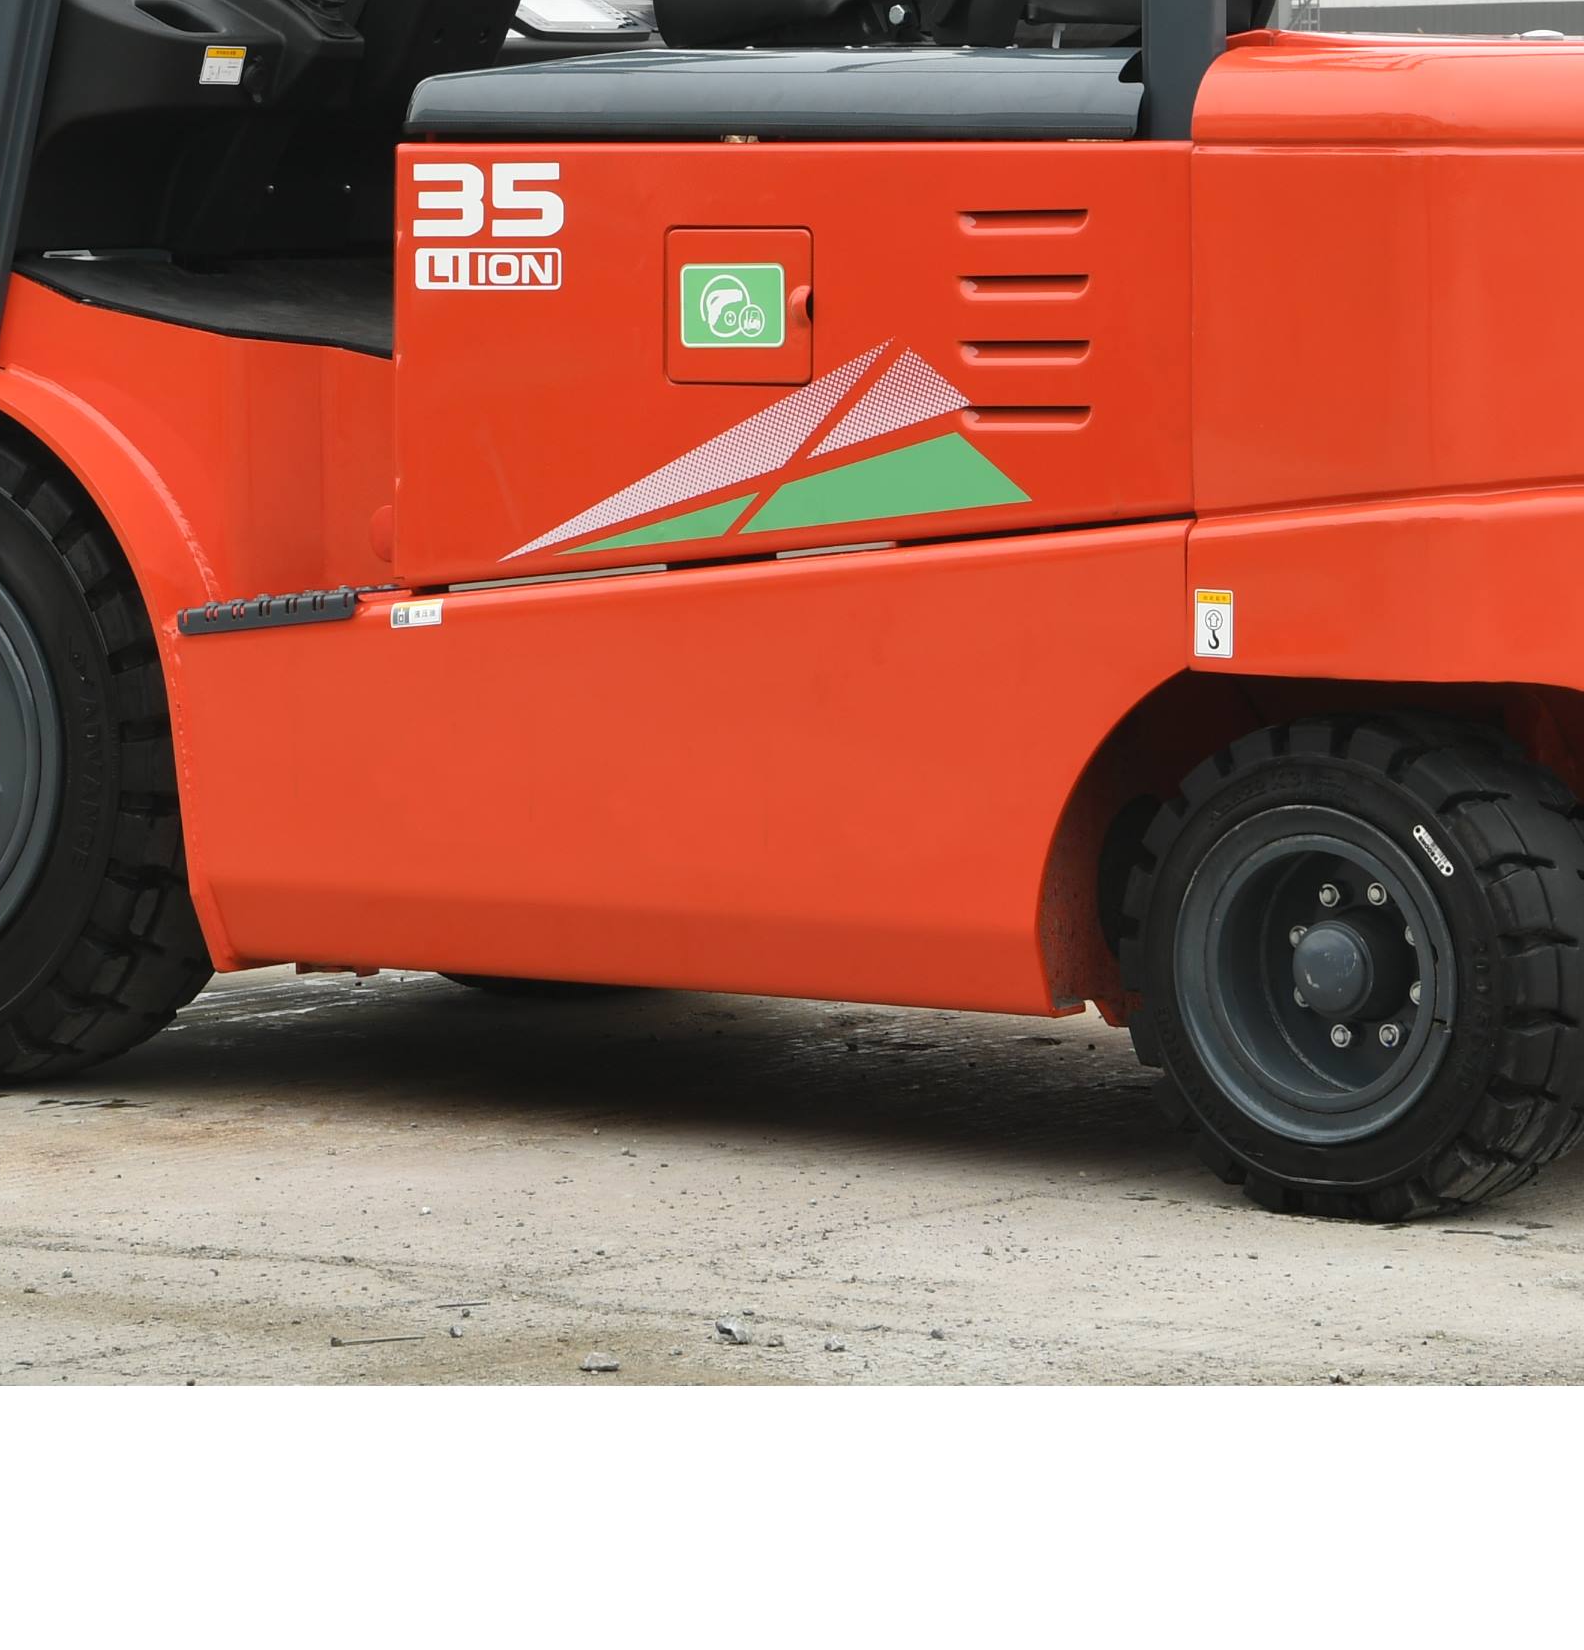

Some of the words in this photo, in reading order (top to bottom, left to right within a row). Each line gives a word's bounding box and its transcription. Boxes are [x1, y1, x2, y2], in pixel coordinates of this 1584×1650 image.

[413, 162, 565, 238] 35
[428, 255, 460, 284] LI
[476, 254, 553, 285] ION
